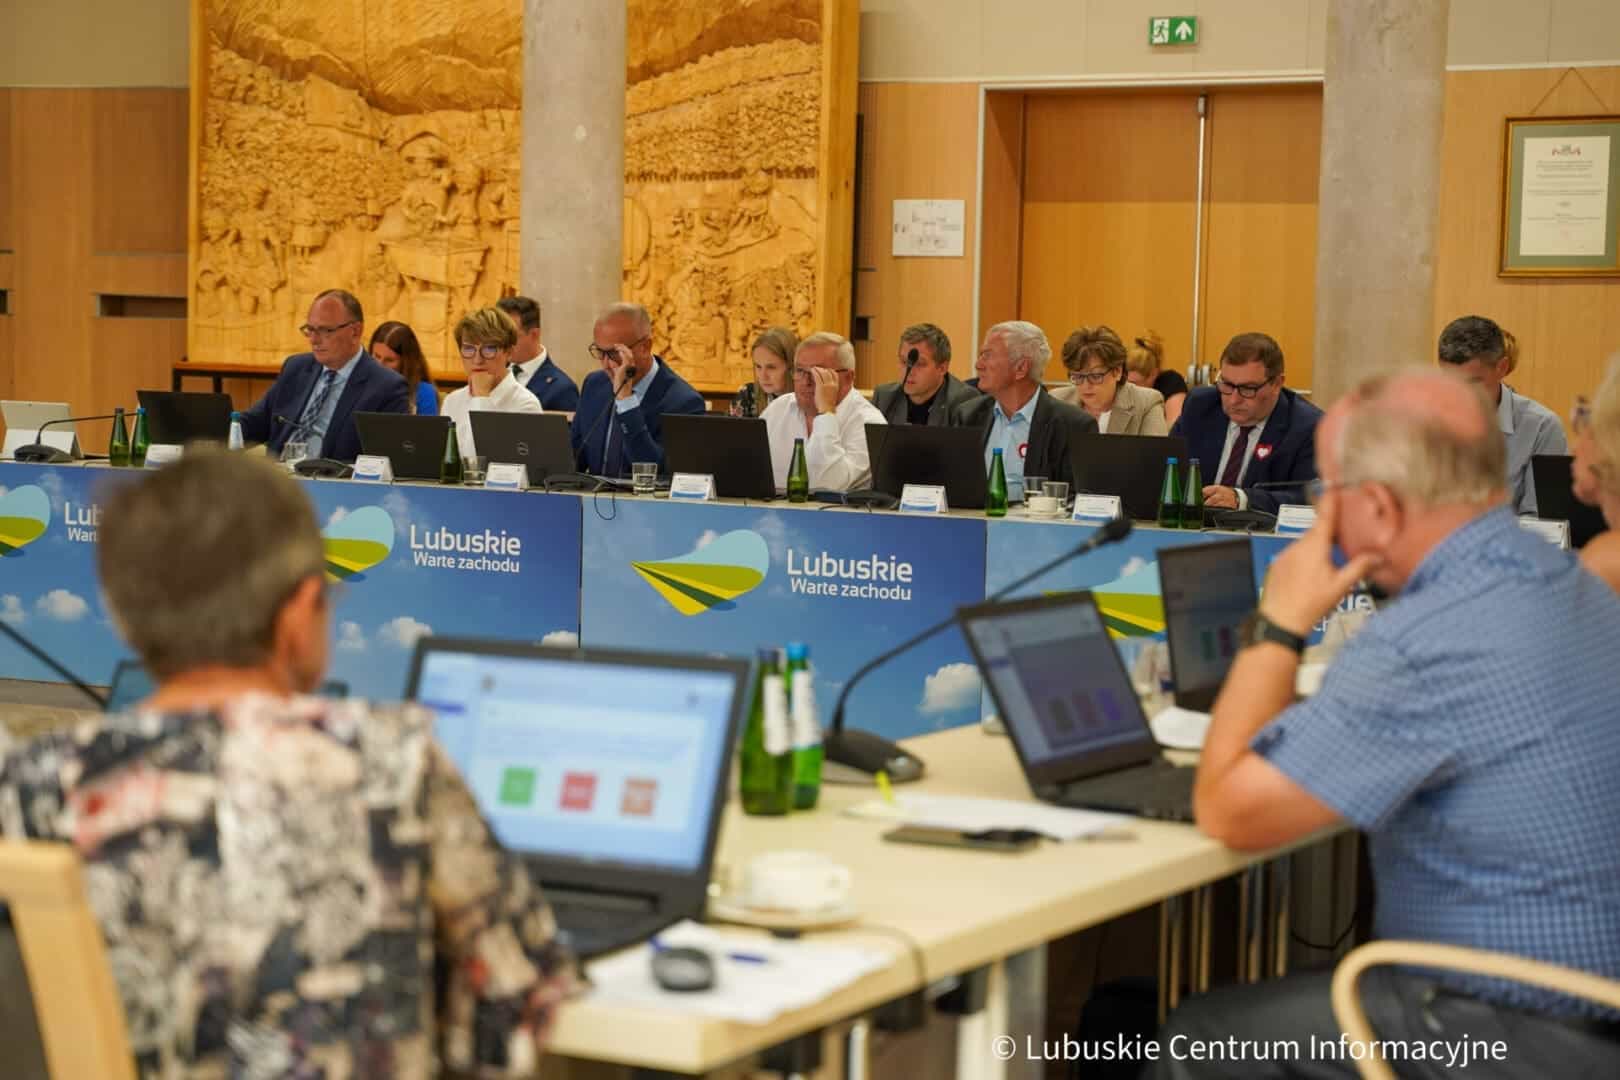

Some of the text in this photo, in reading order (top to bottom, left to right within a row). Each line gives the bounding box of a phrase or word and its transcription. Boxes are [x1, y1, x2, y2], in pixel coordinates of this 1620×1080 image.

[67, 527, 98, 542] Wart
[410, 523, 521, 556] Lubuskie
[413, 551, 520, 573] Warte zachodu
[787, 548, 913, 583] Lubuskie
[790, 577, 912, 601] Warte zachodu
